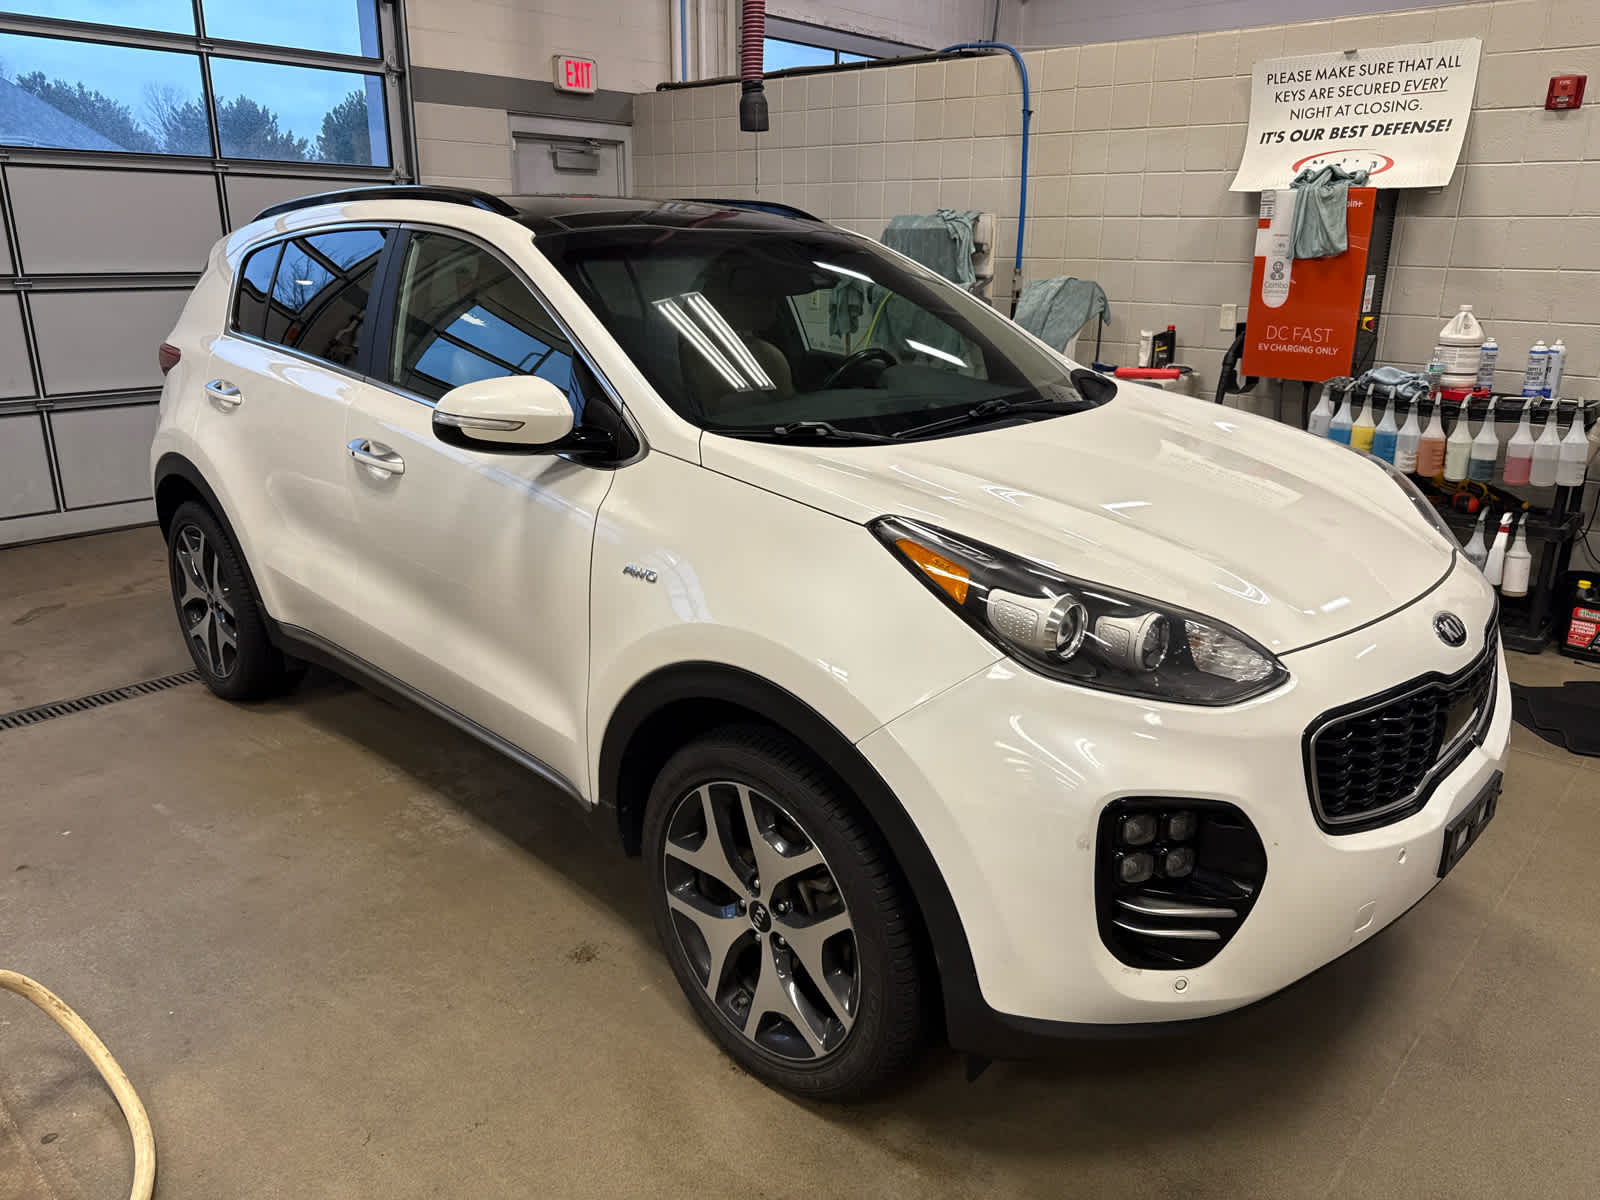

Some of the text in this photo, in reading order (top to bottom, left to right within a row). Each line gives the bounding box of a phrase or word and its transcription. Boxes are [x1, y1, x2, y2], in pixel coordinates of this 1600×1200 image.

[565, 59, 592, 89] EXIT
[1266, 55, 1462, 85] PLEASE MAKE SURE THAT ALL
[1274, 76, 1449, 103] KEYS ARE SECURED EVERY
[1289, 98, 1423, 121] NIGHT AT CLOSING.
[1259, 118, 1453, 145] IT'S OUR BEST DEFENSE!
[1266, 325, 1334, 343] DC FAST
[1258, 342, 1339, 356] EV CHARGING ONLY
[622, 564, 658, 584] AWD
